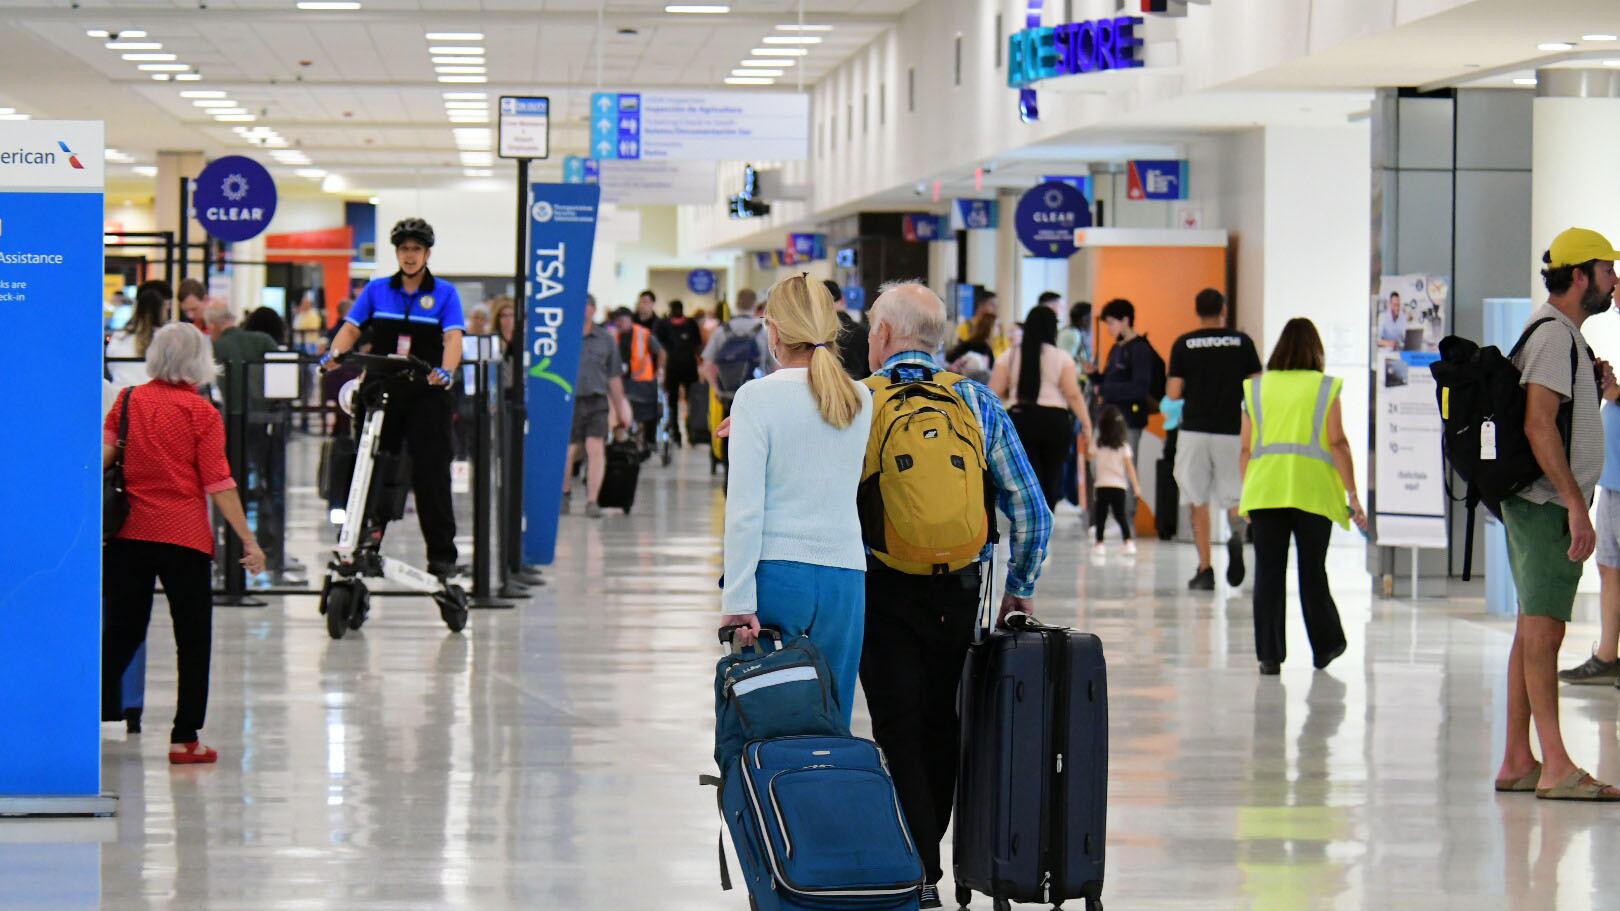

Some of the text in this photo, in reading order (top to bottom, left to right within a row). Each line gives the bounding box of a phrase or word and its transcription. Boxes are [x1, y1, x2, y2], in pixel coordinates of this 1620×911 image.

[1053, 15, 1145, 75] STORE
[206, 207, 264, 221] CLEAR
[1033, 211, 1075, 224] CLEAR
[0, 251, 63, 264] Assistance
[536, 242, 566, 300] TSA
[11, 281, 28, 289] are
[533, 307, 564, 357] Pre
